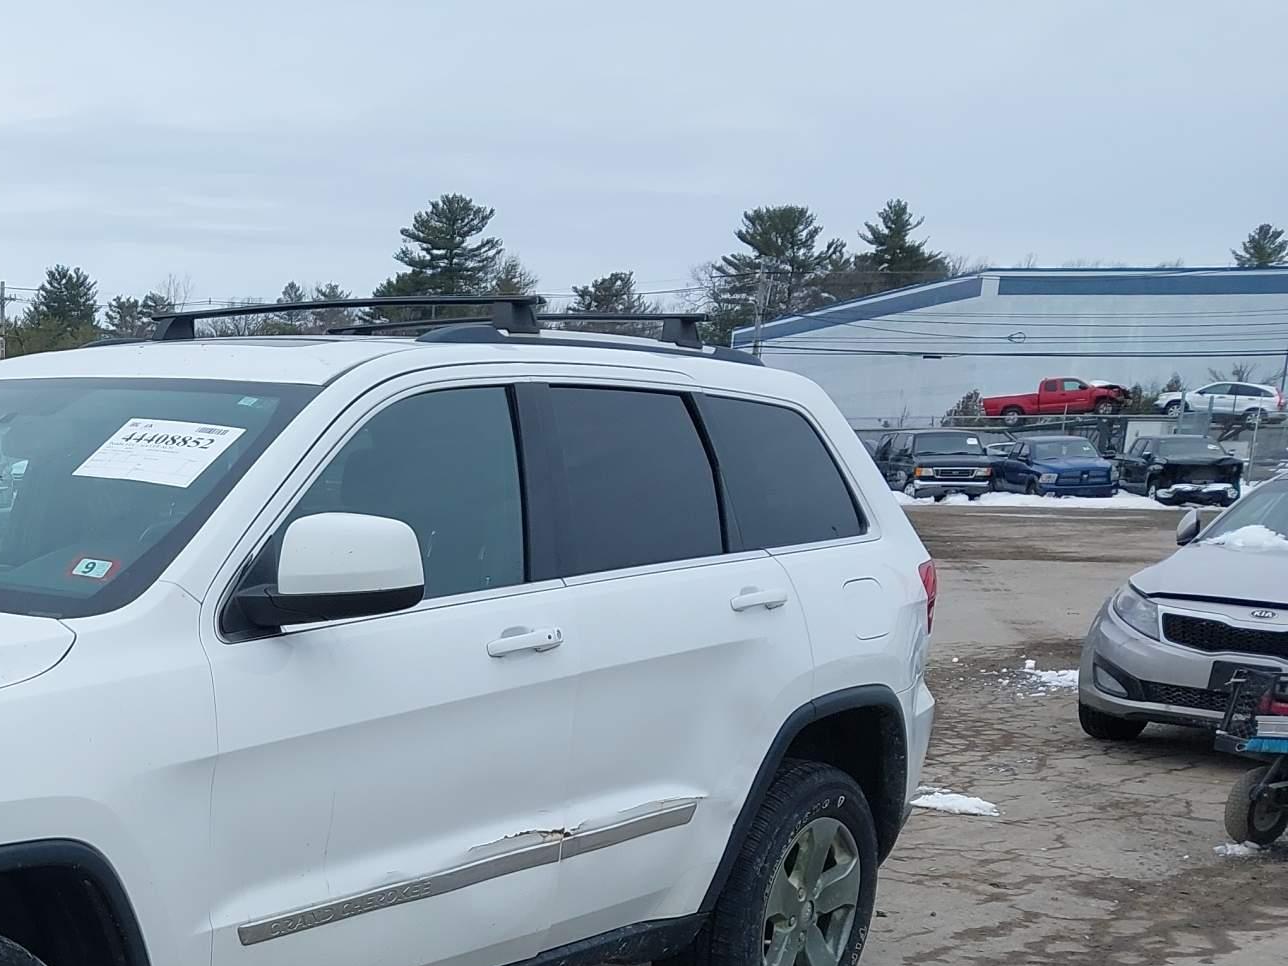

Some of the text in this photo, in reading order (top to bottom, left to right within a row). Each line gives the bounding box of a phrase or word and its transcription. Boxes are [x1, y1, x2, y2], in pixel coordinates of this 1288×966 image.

[121, 431, 216, 450] 44408852
[81, 561, 97, 574] 9
[1253, 610, 1273, 618] KIA
[343, 881, 432, 918] CHEROKEE
